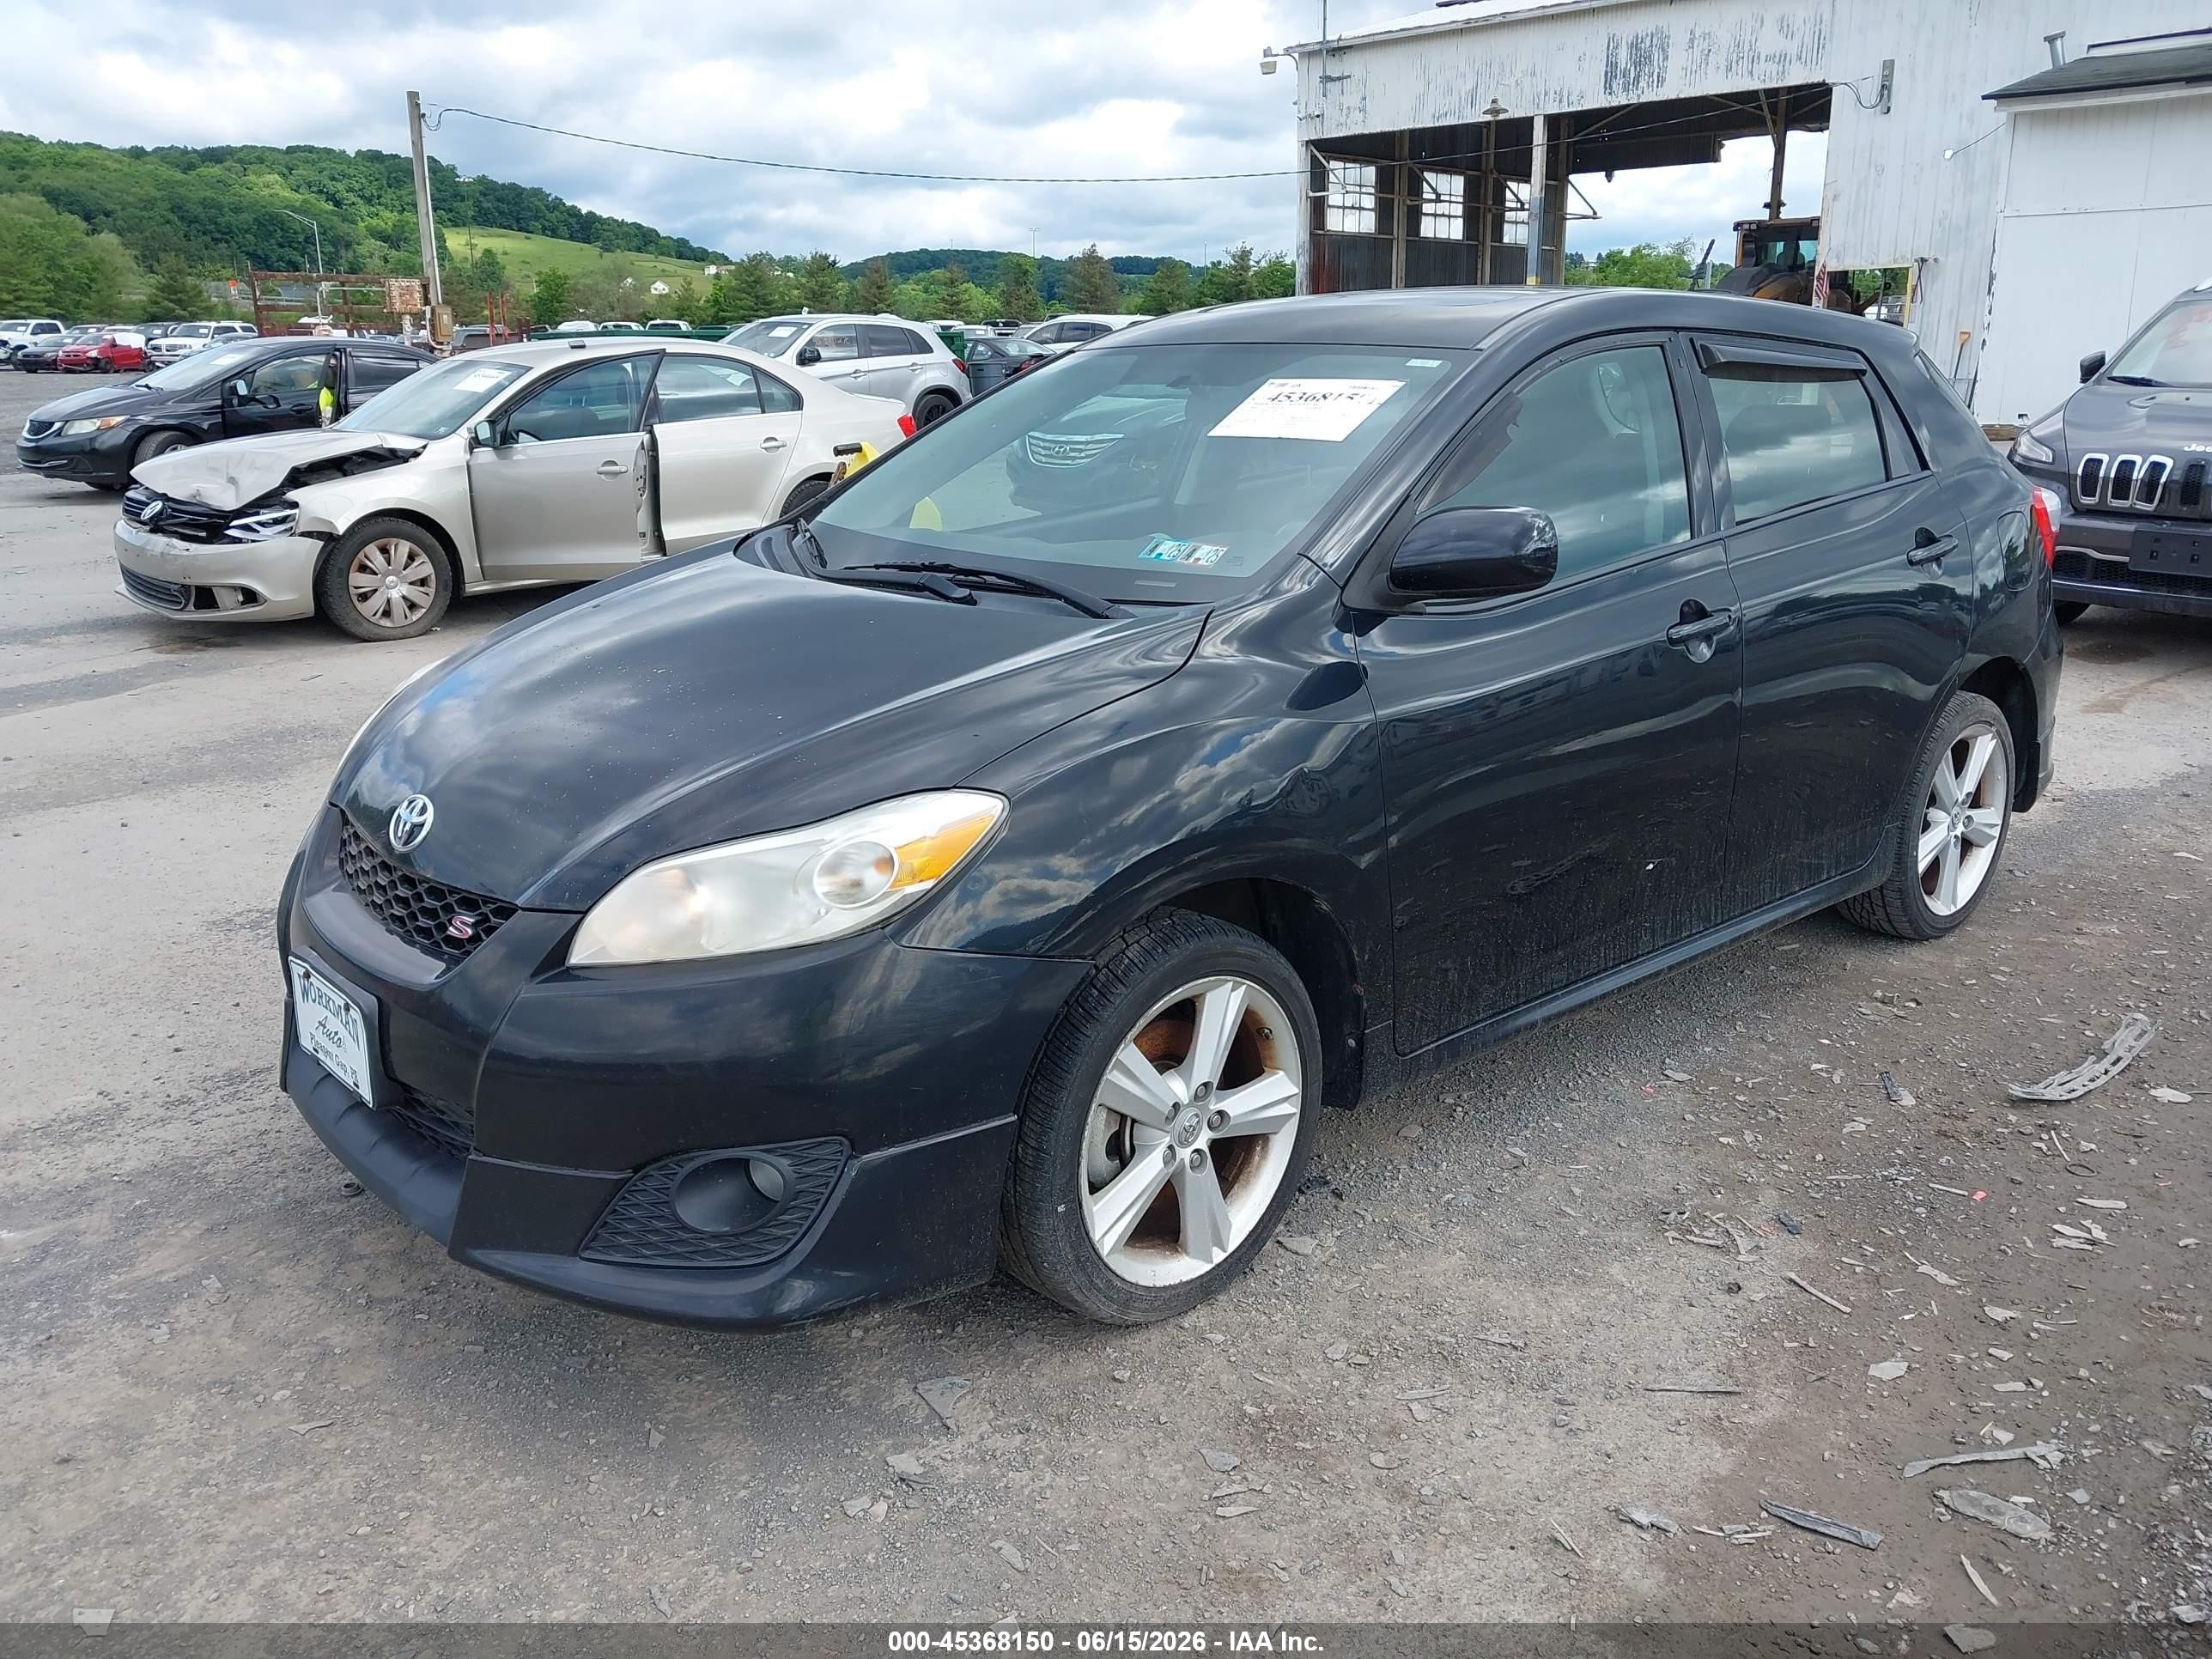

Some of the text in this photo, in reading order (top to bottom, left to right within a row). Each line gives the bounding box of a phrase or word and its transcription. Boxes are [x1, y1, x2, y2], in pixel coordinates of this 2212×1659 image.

[446, 916, 475, 939] S
[296, 972, 361, 1052] WORKMAN
[315, 1015, 343, 1048] Auto
[308, 1030, 334, 1063] Pleasant
[334, 1053, 349, 1079] Gap,
